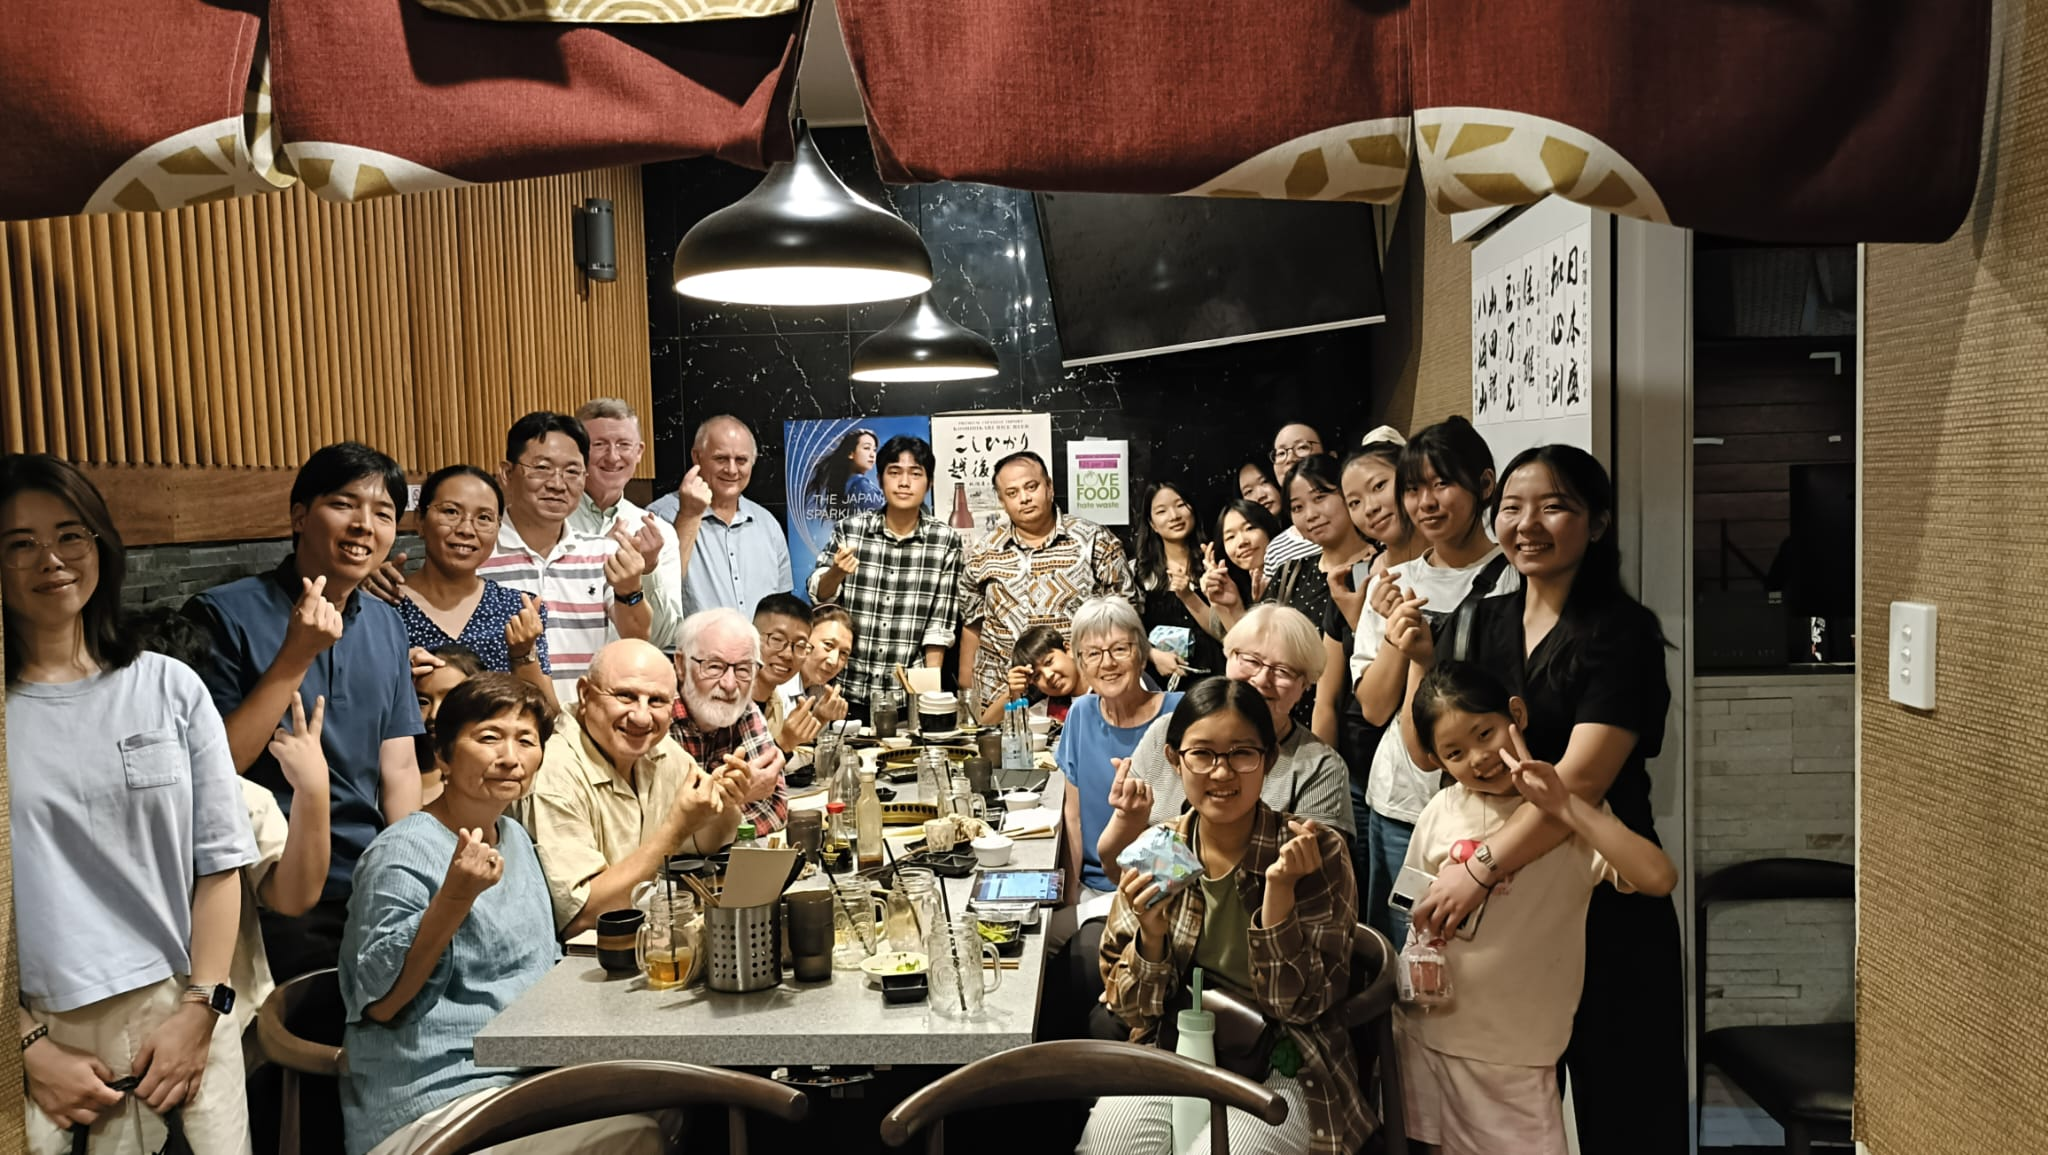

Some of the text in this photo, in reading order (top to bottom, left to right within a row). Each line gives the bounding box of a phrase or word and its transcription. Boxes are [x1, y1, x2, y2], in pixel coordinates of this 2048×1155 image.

[955, 432, 1029, 453] こしひかり
[1076, 472, 1119, 487] LOVE
[813, 493, 882, 505] THE JAPAN
[1076, 487, 1121, 501] FOOD
[1096, 501, 1119, 509] waste
